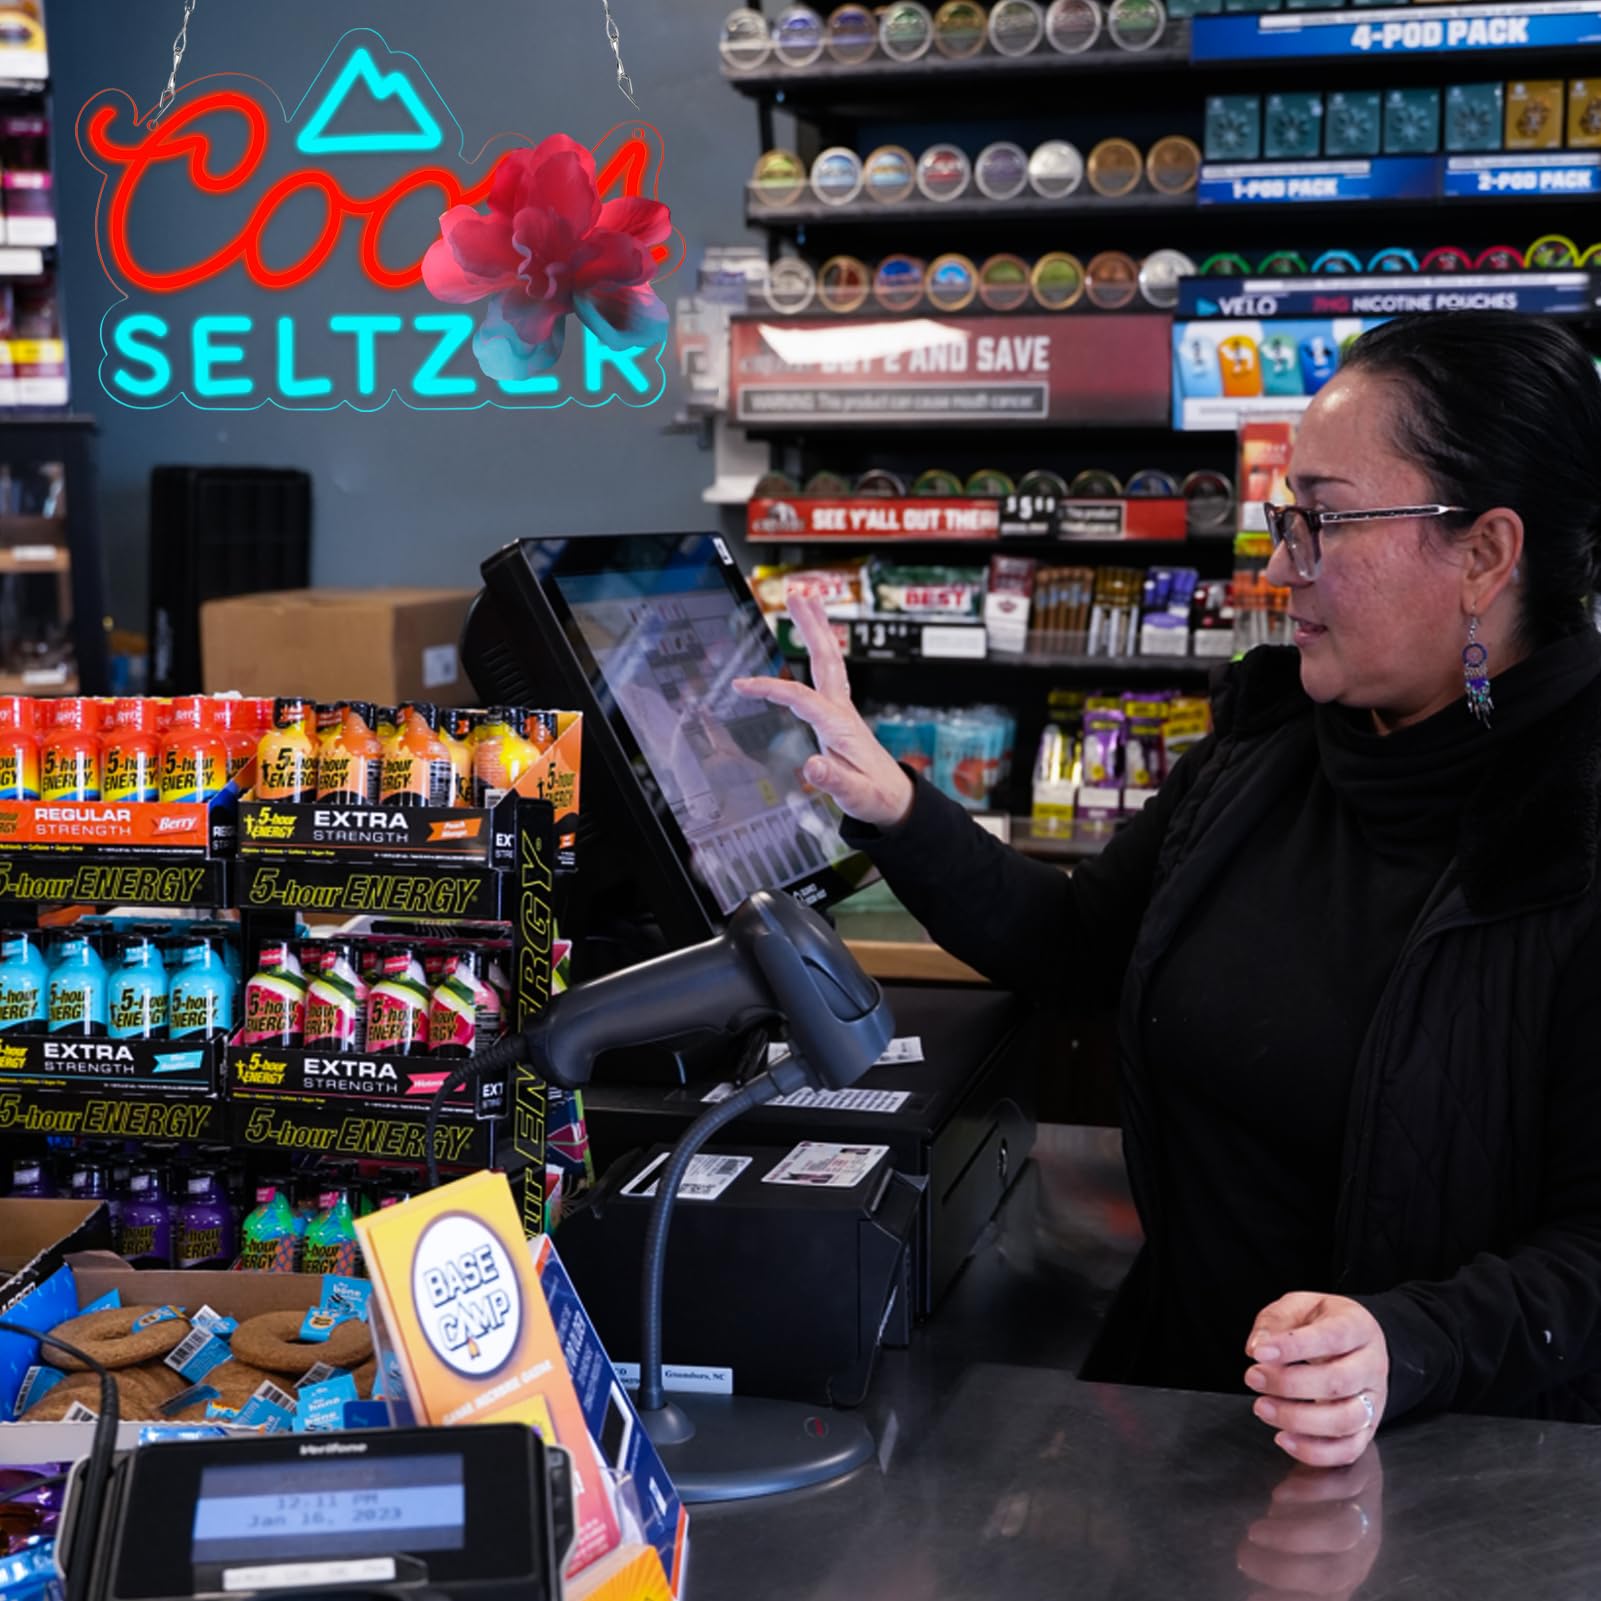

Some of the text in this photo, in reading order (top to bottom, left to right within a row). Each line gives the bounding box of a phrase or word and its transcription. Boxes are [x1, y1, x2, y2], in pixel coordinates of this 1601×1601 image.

[1351, 17, 1529, 50] 4-POD PACK
[1232, 178, 1338, 198] 1-POD PACK
[1478, 170, 1592, 190] 2-POD PACK
[1219, 297, 1277, 316] VELO
[1353, 294, 1432, 312] NICOTINE
[1436, 292, 1518, 311] POUCHES
[976, 336, 1051, 372] SAVE
[812, 508, 847, 530] SEE
[903, 508, 940, 530] OUT
[107, 751, 158, 774] 5-hur
[104, 772, 156, 792] ENERY
[163, 771, 214, 792] ENERY
[34, 807, 131, 822] REGULAR
[158, 816, 198, 832] Berry
[258, 806, 297, 825] 5-hour
[314, 810, 409, 830] EXTRA
[36, 823, 131, 837] STRENGTH
[252, 825, 296, 839] ENERGY
[313, 830, 409, 844] STRENGTH
[72, 866, 204, 902] ENERGY
[250, 867, 481, 914] 5-hour ENERGY
[50, 982, 93, 1004] 5-hou
[515, 829, 552, 1166] ENRGY
[116, 1009, 168, 1028] ENEGY
[44, 1042, 135, 1061] EXTRA
[44, 1061, 135, 1074] STRENGTH
[249, 1053, 288, 1072] 5-hour
[304, 1057, 398, 1079] EXTRA
[245, 1071, 285, 1085] ENERGY
[303, 1077, 398, 1093] STRENGTH
[82, 1100, 211, 1138] ENERGY
[245, 1107, 337, 1149] 5-hour
[423, 1244, 499, 1308] BASE
[438, 1289, 512, 1352] CAMP
[248, 1513, 288, 1528] Jan
[352, 1506, 402, 1523] 2023
